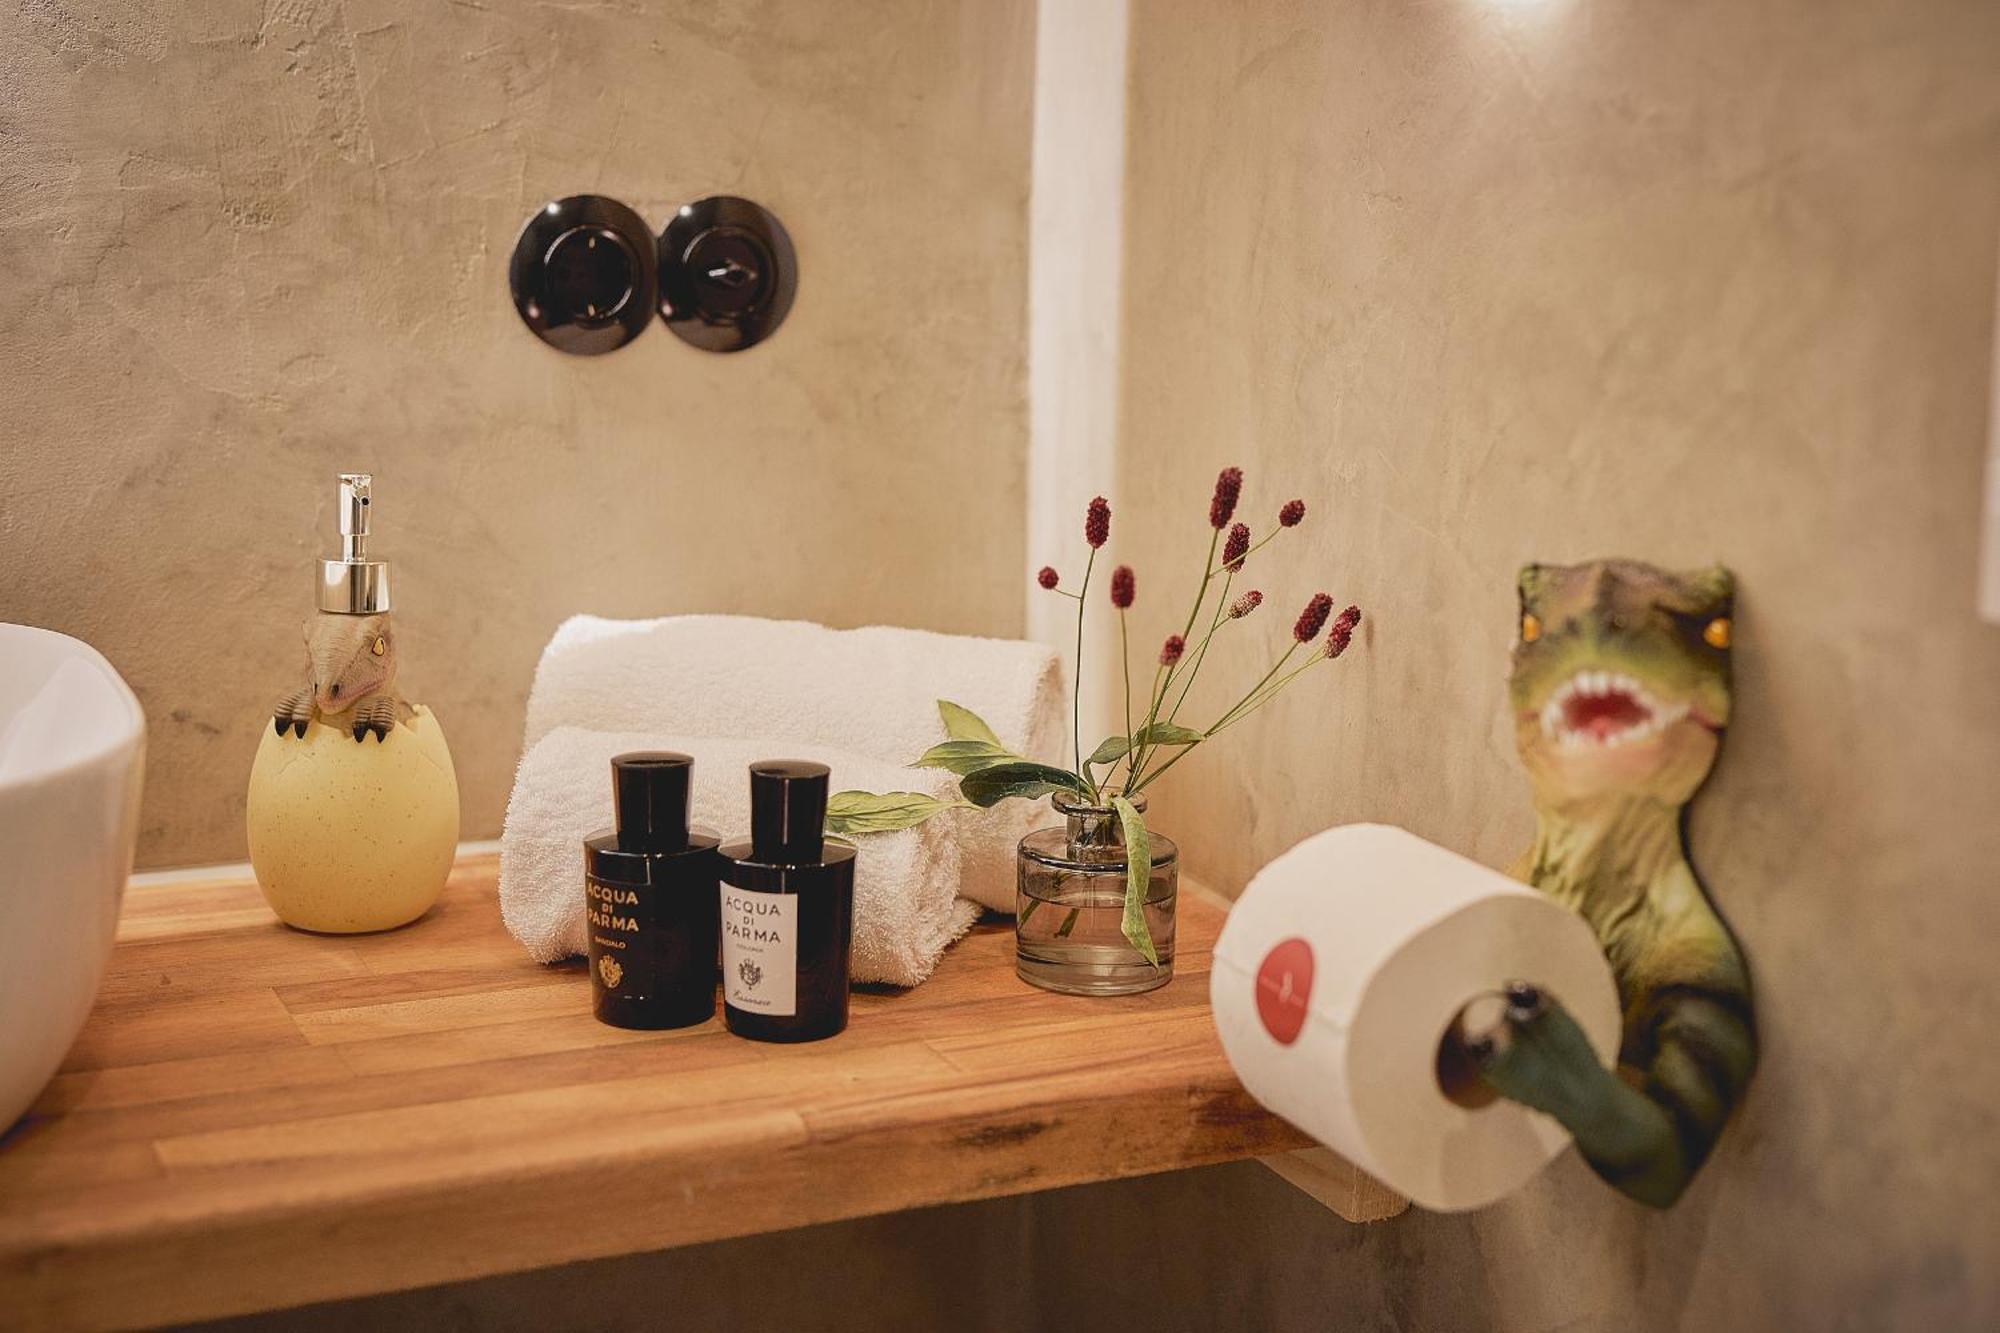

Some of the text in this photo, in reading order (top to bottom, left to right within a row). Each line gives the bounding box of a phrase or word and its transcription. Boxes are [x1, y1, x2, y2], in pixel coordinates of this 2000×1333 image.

[587, 882, 639, 905] ACQUA
[602, 904, 613, 913] DI
[726, 896, 781, 916] ACQUA
[588, 908, 639, 932] PARMA
[743, 916, 754, 926] DI
[726, 921, 781, 943] PARMA
